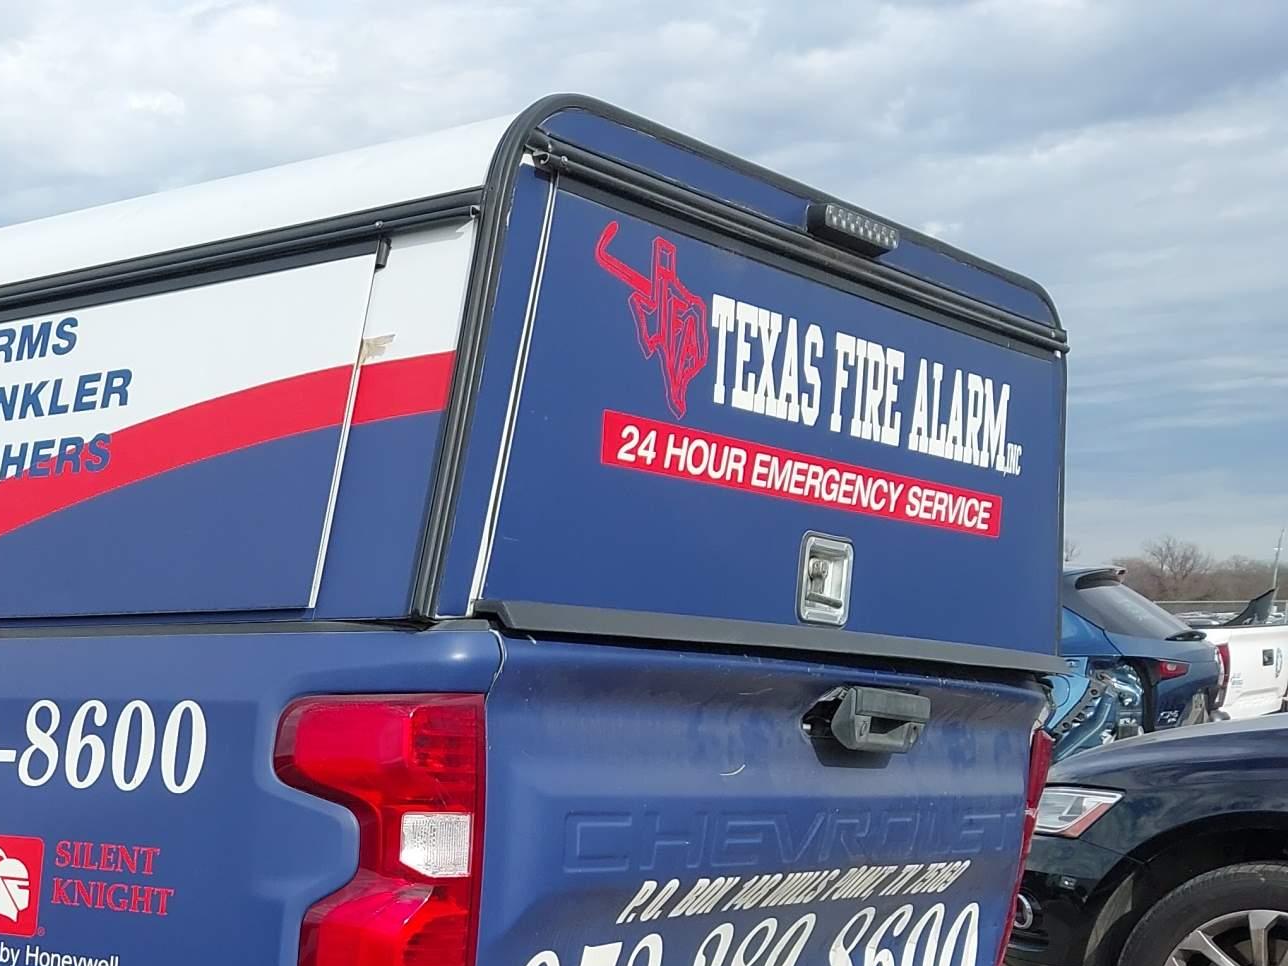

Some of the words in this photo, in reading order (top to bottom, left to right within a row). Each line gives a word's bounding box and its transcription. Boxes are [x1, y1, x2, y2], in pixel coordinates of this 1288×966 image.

[712, 294, 823, 426] TEXAS
[830, 333, 905, 446] FIRE
[617, 424, 657, 465] 24
[663, 433, 746, 484] HOUR
[751, 451, 905, 513] EMERGENCY
[905, 485, 993, 530] SERVICE
[55, 840, 160, 875] SILENT
[563, 806, 1019, 873] CHEVROLET
[50, 877, 174, 916] KNIGHT
[616, 879, 679, 924] P.O.
[667, 876, 741, 918] BOX
[879, 864, 925, 896] TX
[902, 859, 971, 894] 75169
